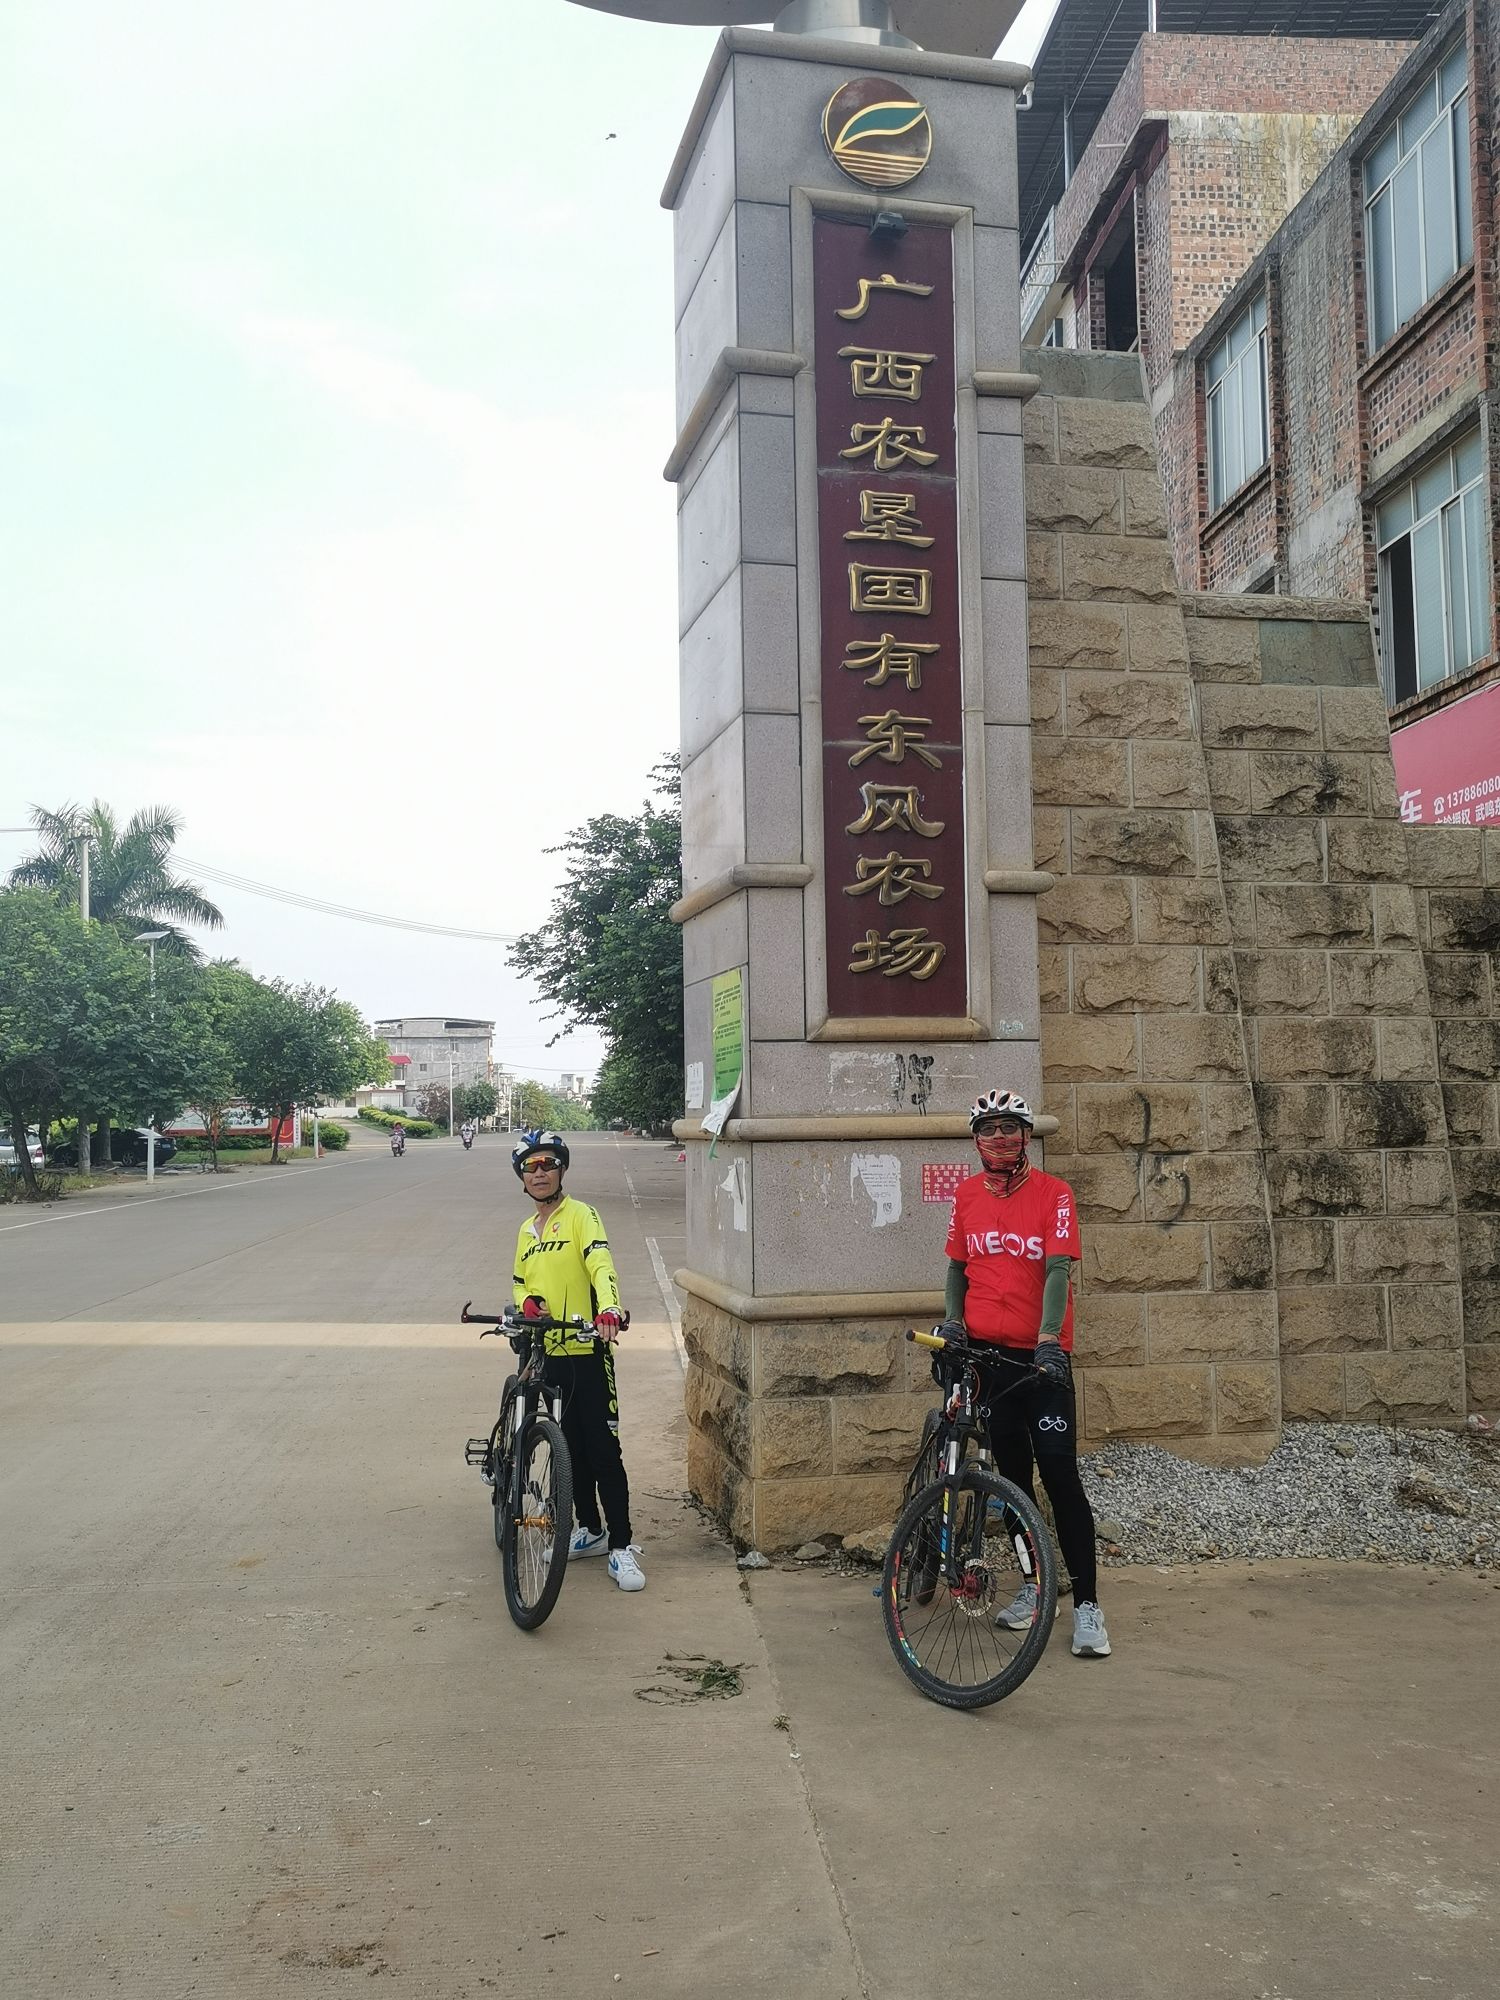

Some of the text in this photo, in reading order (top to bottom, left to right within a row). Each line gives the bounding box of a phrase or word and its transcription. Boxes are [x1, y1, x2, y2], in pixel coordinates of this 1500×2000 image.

[835, 273, 945, 981] 广西农垦国有东风农场
[1056, 1194, 1070, 1238] INEOS
[966, 1231, 1044, 1260] INEOS
